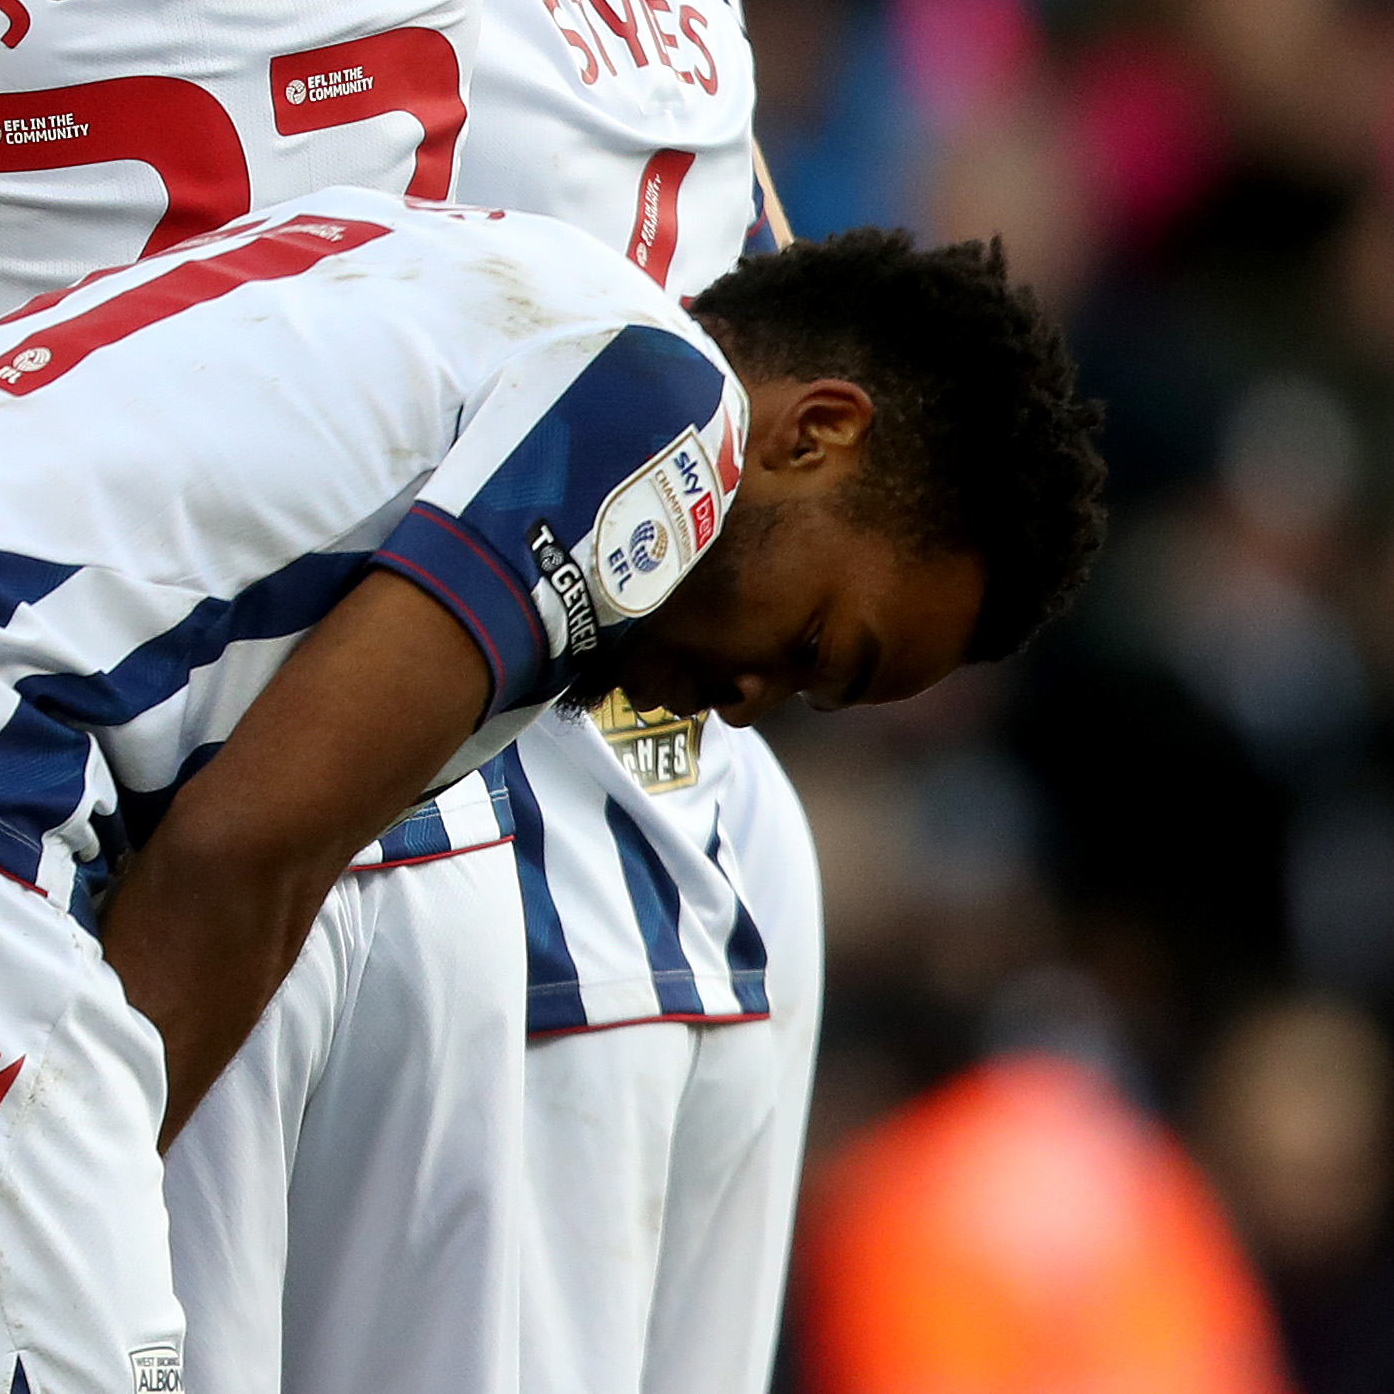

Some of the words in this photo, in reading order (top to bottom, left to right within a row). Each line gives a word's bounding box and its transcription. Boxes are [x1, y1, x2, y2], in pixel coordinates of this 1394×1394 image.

[307, 74, 328, 88] EFL
[328, 71, 342, 85] IN
[342, 66, 364, 82] THE
[309, 76, 374, 102] COMMUNITY
[4, 119, 29, 132] EFL
[30, 117, 46, 130] IN
[47, 113, 74, 128] THE
[5, 124, 89, 145] COMMUNITY
[674, 451, 703, 496] sky
[608, 547, 633, 593] EFL
